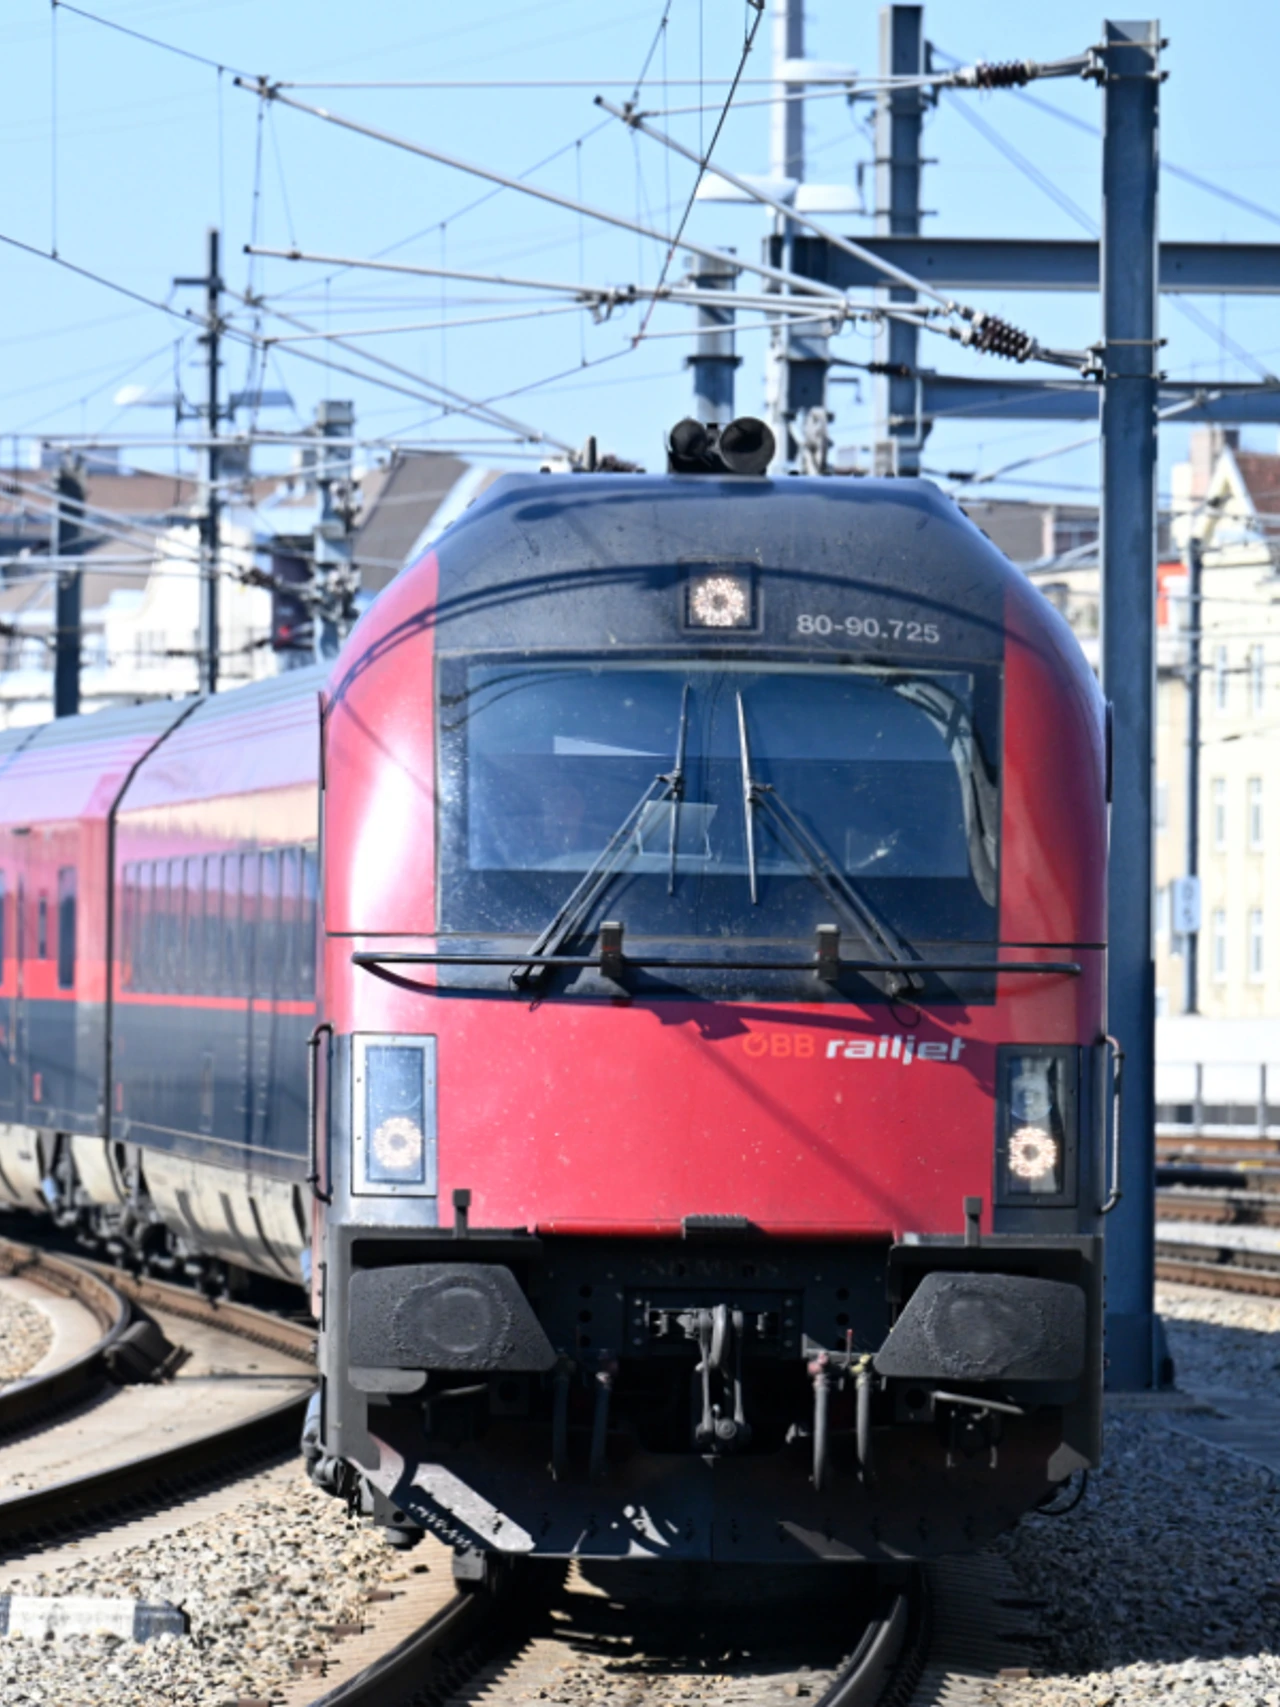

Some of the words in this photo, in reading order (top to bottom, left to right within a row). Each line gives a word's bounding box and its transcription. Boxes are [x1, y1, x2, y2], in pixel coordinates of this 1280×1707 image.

[797, 614, 940, 643] 80-90.725
[742, 1032, 815, 1058] ÖBB
[825, 1034, 965, 1065] railjet
